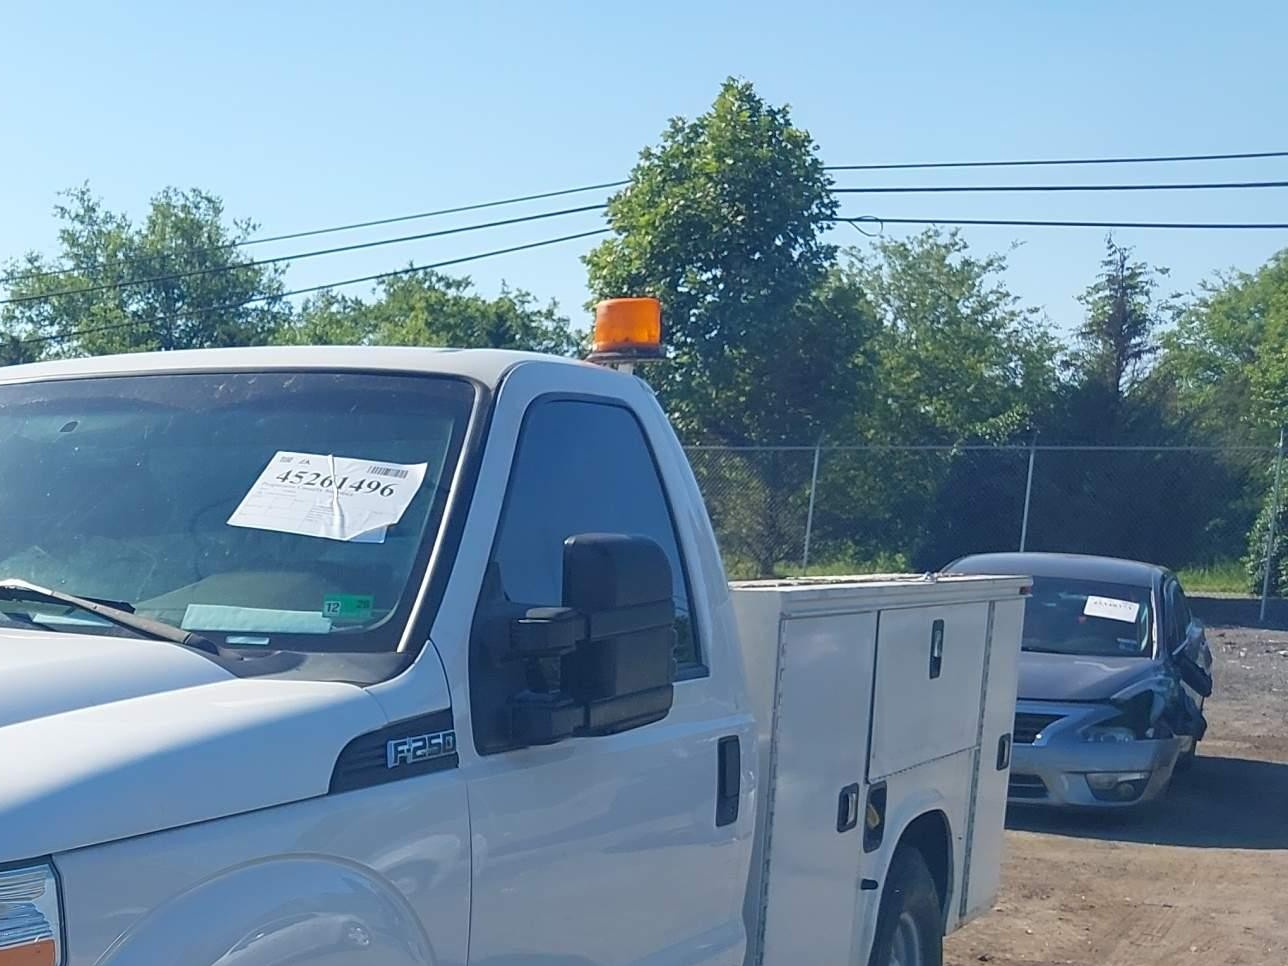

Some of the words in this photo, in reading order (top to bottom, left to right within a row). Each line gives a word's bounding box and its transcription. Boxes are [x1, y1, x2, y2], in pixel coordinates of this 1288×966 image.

[275, 469, 400, 498] 45261496
[327, 602, 340, 613] 12
[387, 730, 456, 769] F-250
